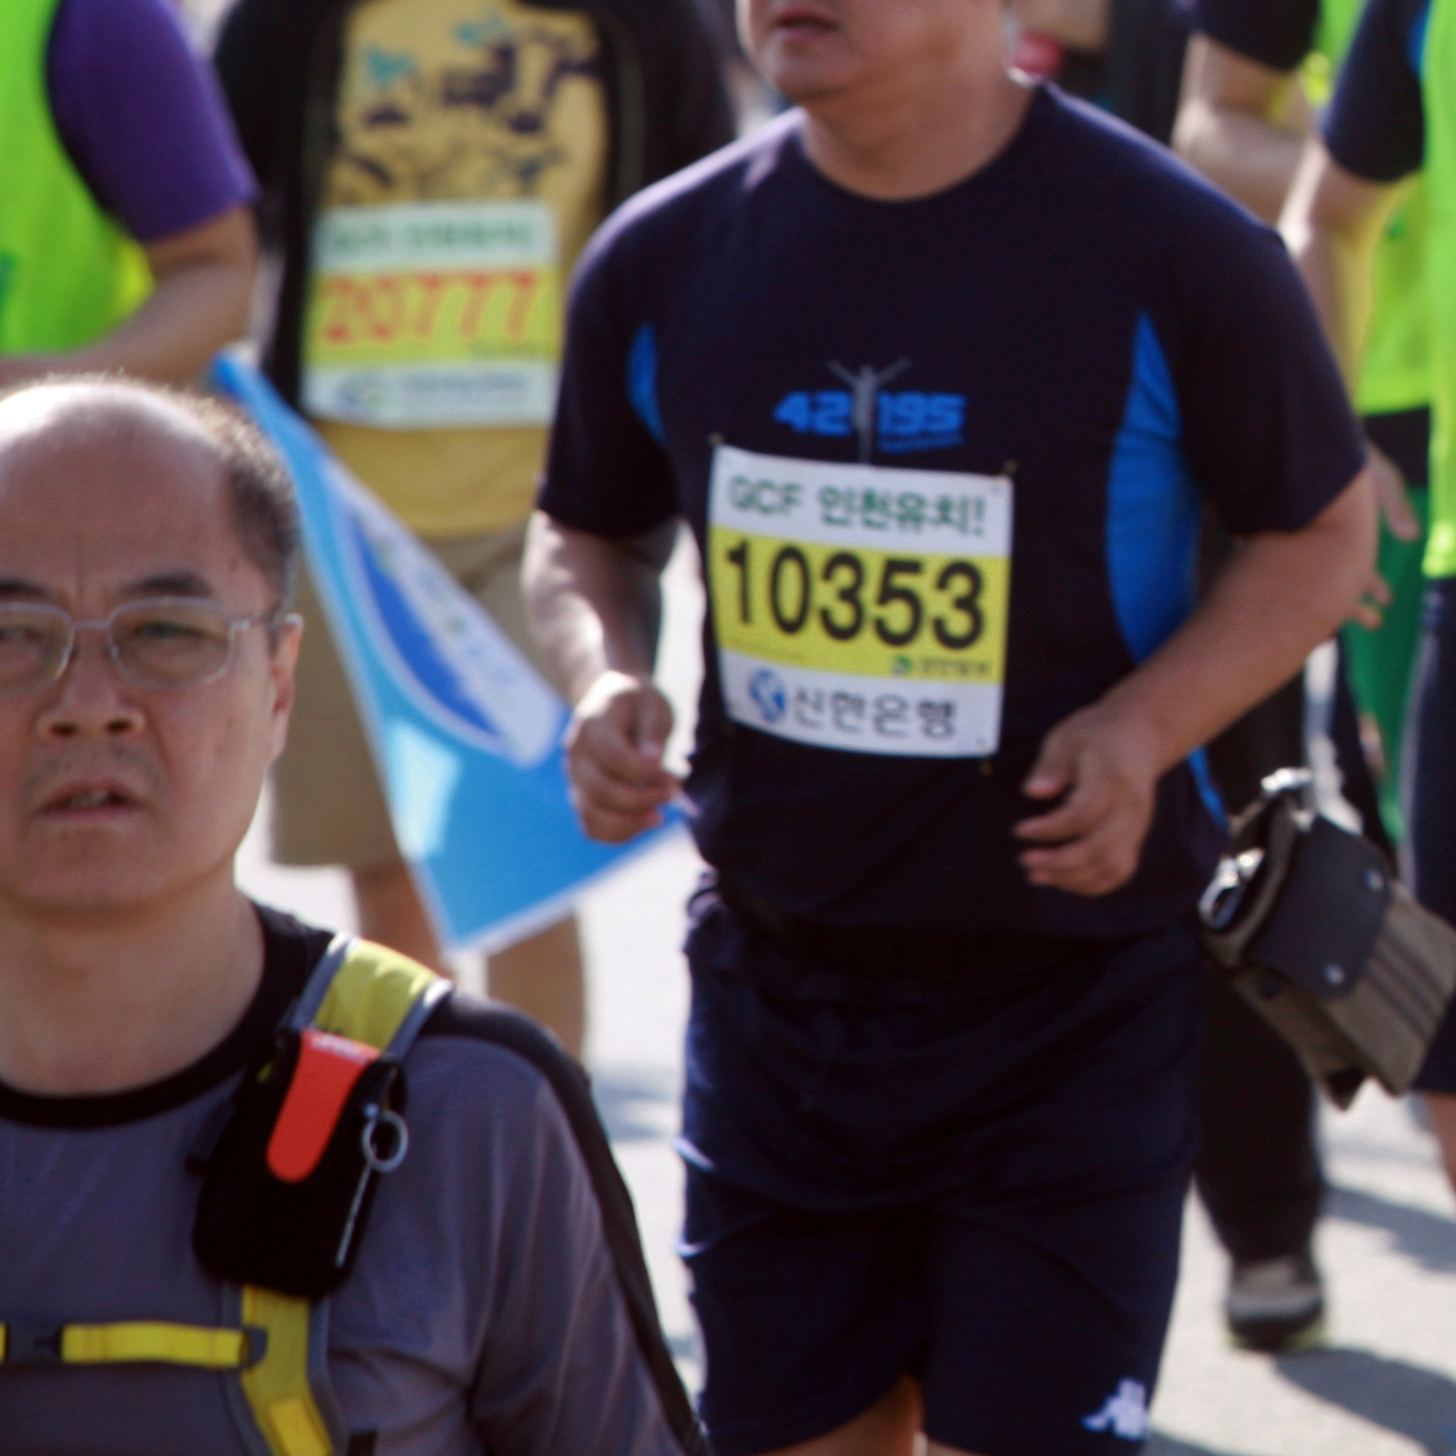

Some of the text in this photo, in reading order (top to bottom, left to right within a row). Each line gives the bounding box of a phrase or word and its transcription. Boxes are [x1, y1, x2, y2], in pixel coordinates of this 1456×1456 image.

[318, 270, 540, 347] 20777
[729, 476, 802, 516] GCF
[726, 537, 985, 652] 10353
[793, 687, 957, 742] 신한은행
